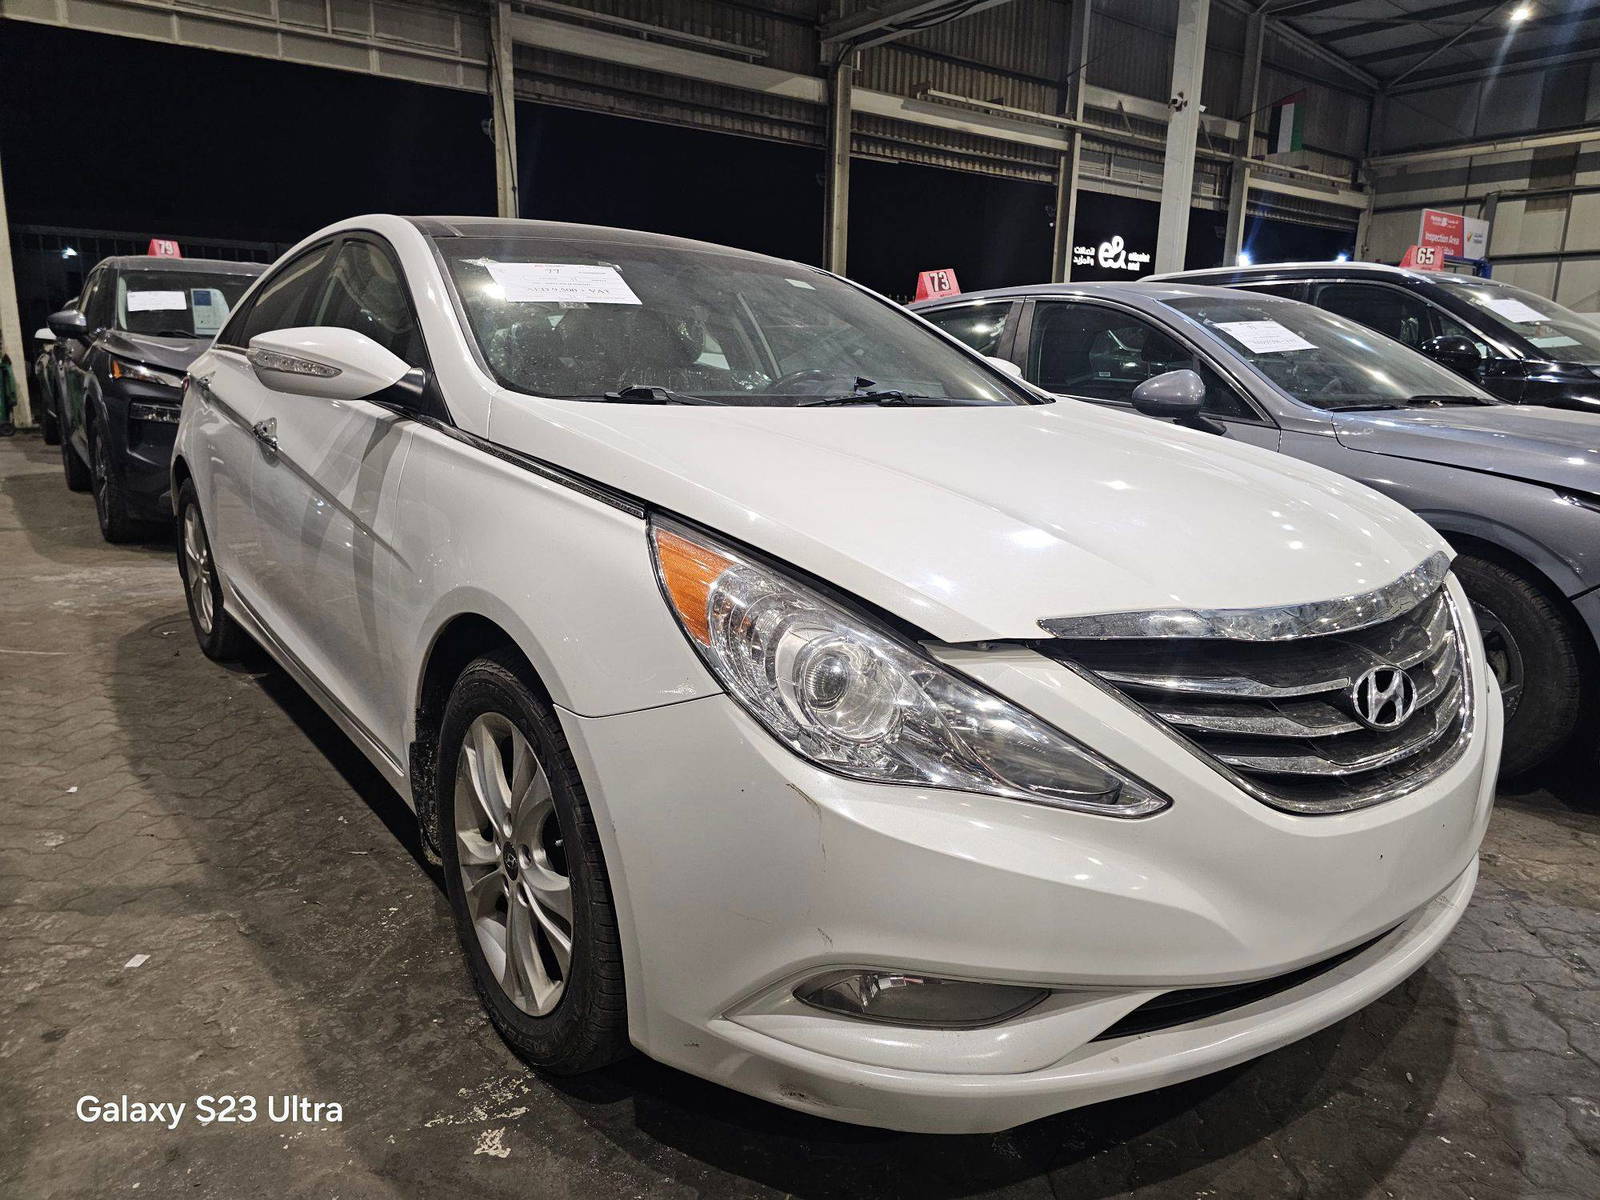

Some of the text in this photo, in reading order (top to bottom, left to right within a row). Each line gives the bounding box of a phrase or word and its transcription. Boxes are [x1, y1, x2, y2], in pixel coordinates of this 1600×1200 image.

[1425, 232, 1460, 245] Inspection Area
[159, 241, 174, 255] 79
[1416, 247, 1435, 264] 65
[929, 271, 950, 292] 73
